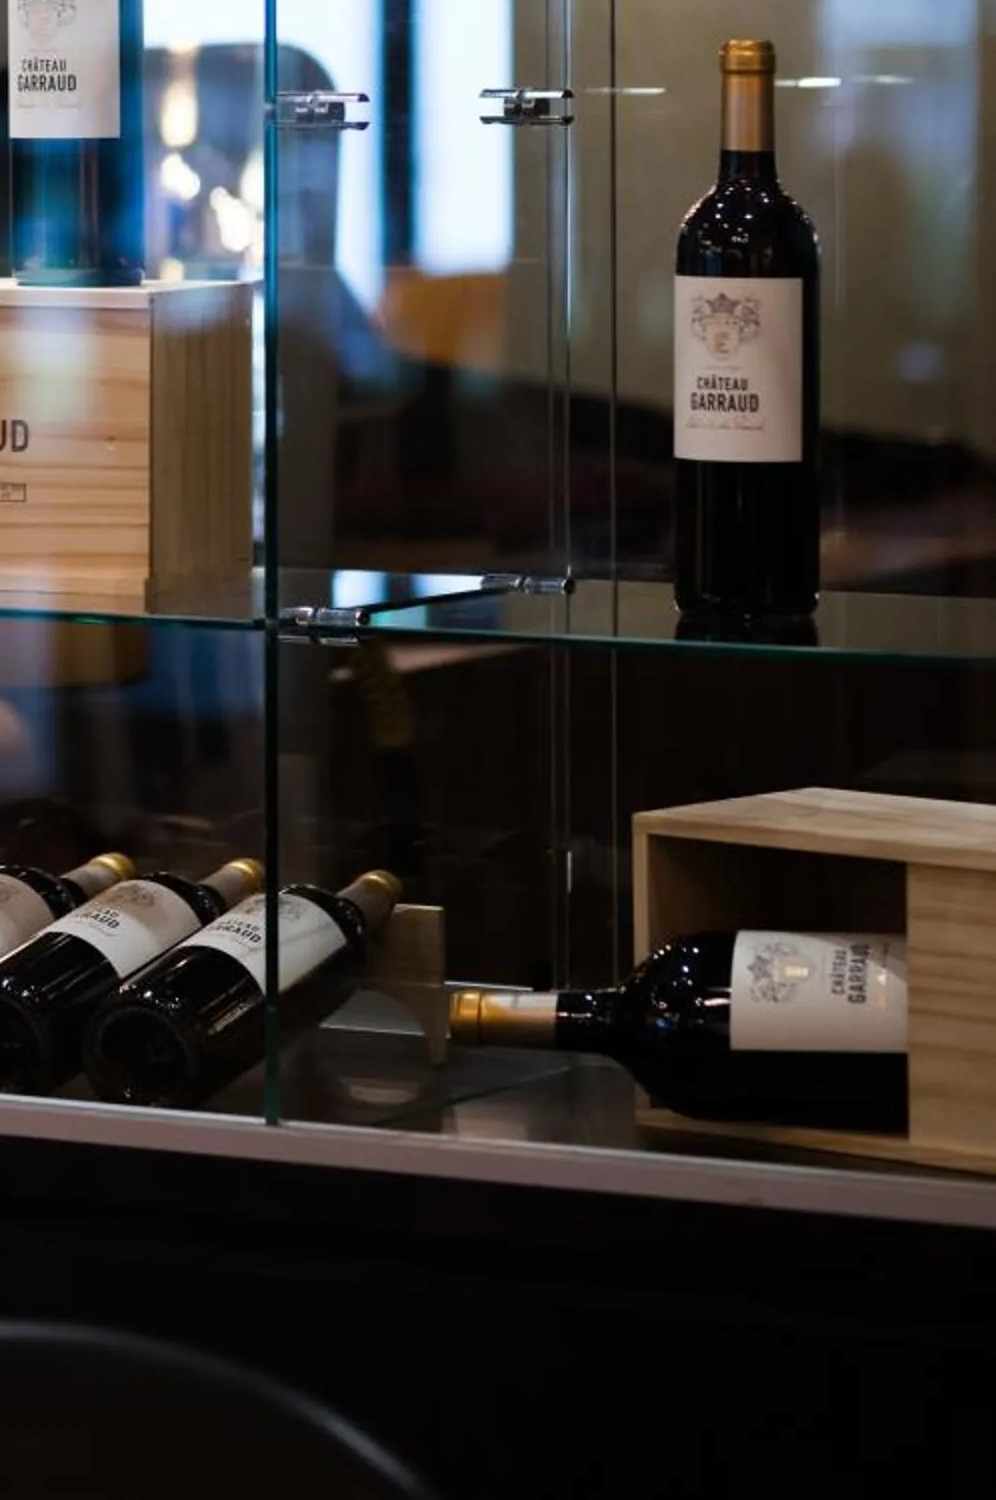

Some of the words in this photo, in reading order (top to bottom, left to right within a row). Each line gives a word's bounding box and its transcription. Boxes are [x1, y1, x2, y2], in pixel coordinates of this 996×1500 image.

[17, 74, 78, 93] GARRAUD
[697, 374, 749, 391] CHÂTEAU
[690, 392, 760, 413] GARRAUD
